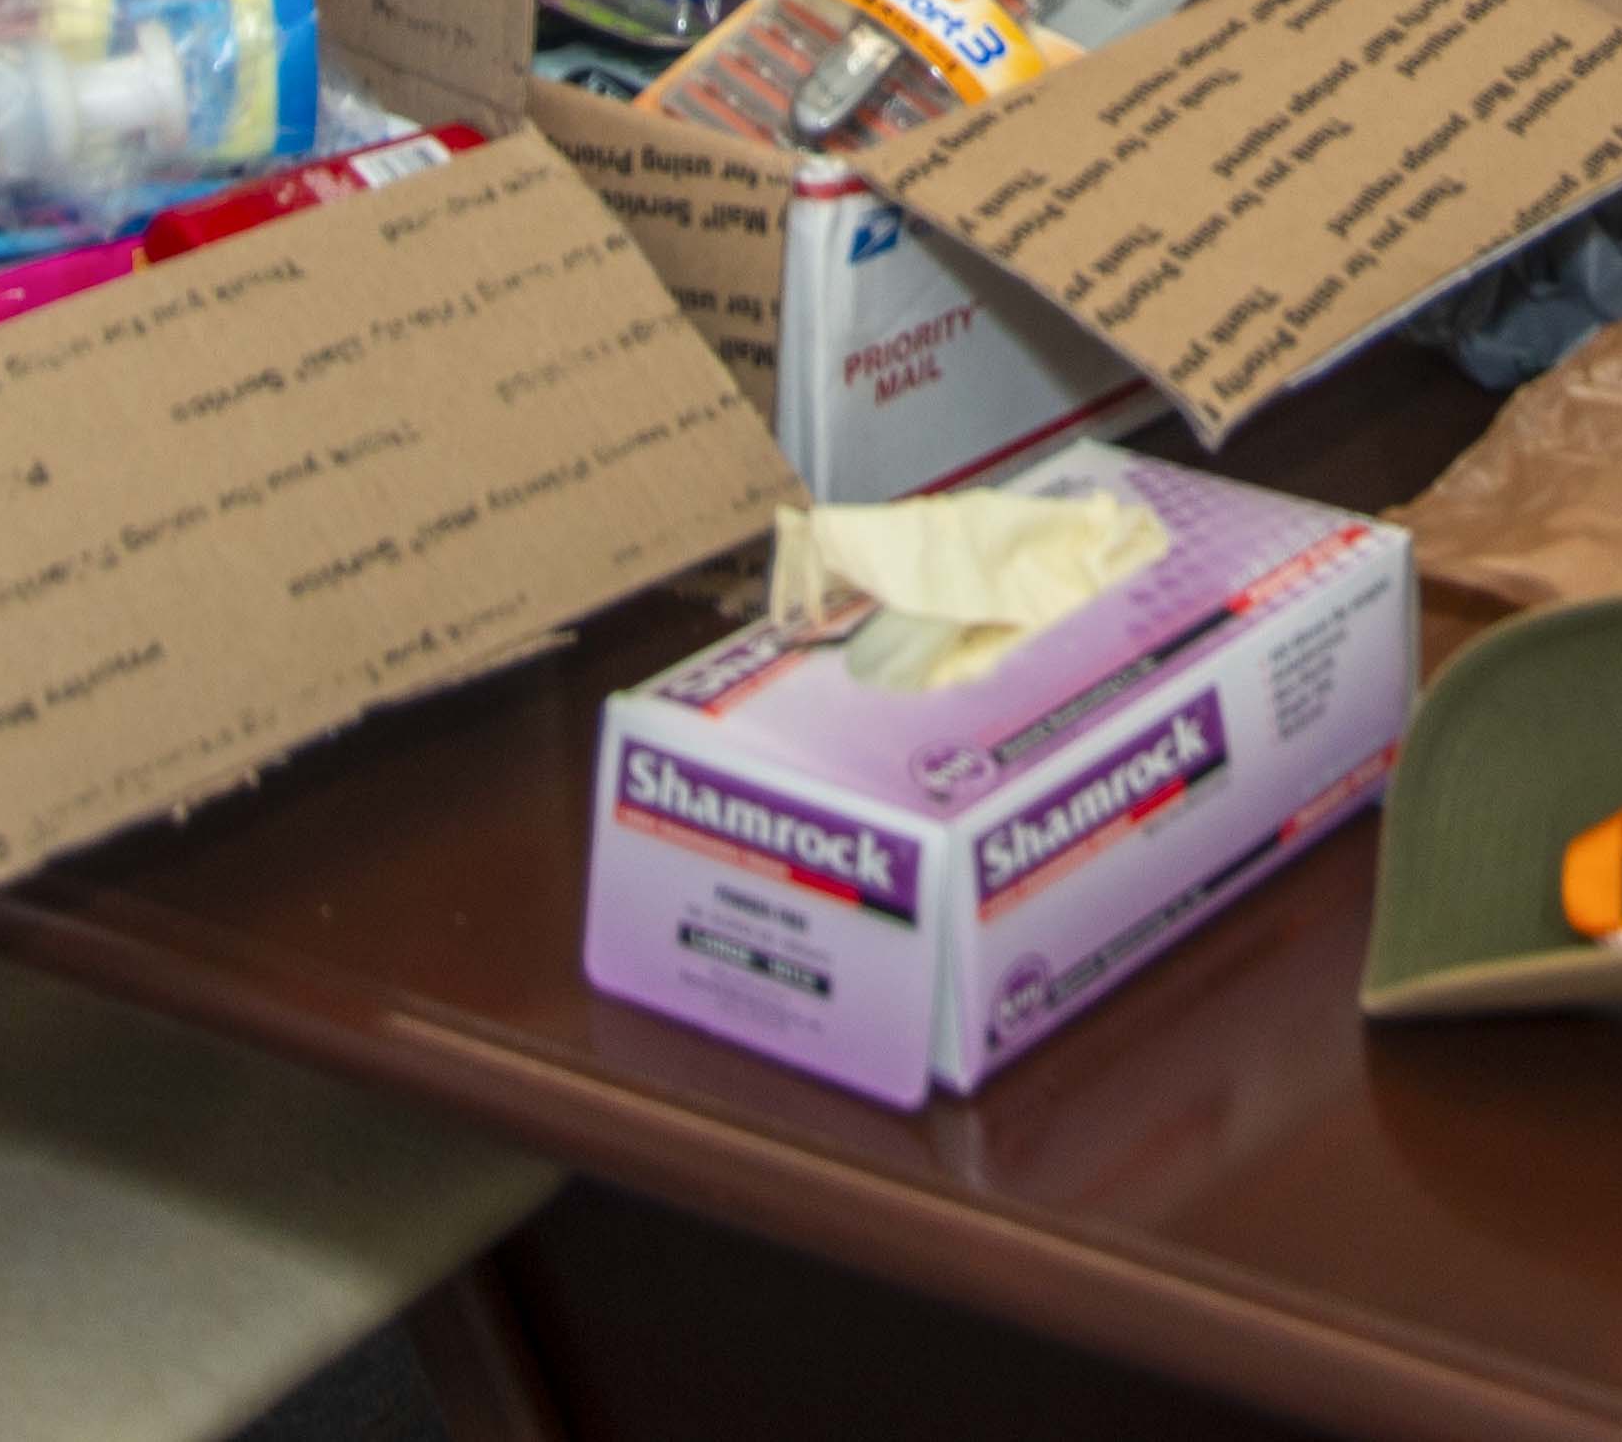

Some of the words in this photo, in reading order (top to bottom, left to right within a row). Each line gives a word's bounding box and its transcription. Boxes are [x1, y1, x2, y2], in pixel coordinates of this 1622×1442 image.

[956, 23, 1009, 69] 3
[842, 307, 976, 386] PRIORITY
[874, 357, 947, 409] MAIL
[623, 749, 897, 894] Shamrock
[978, 712, 1210, 886] Shamrock
